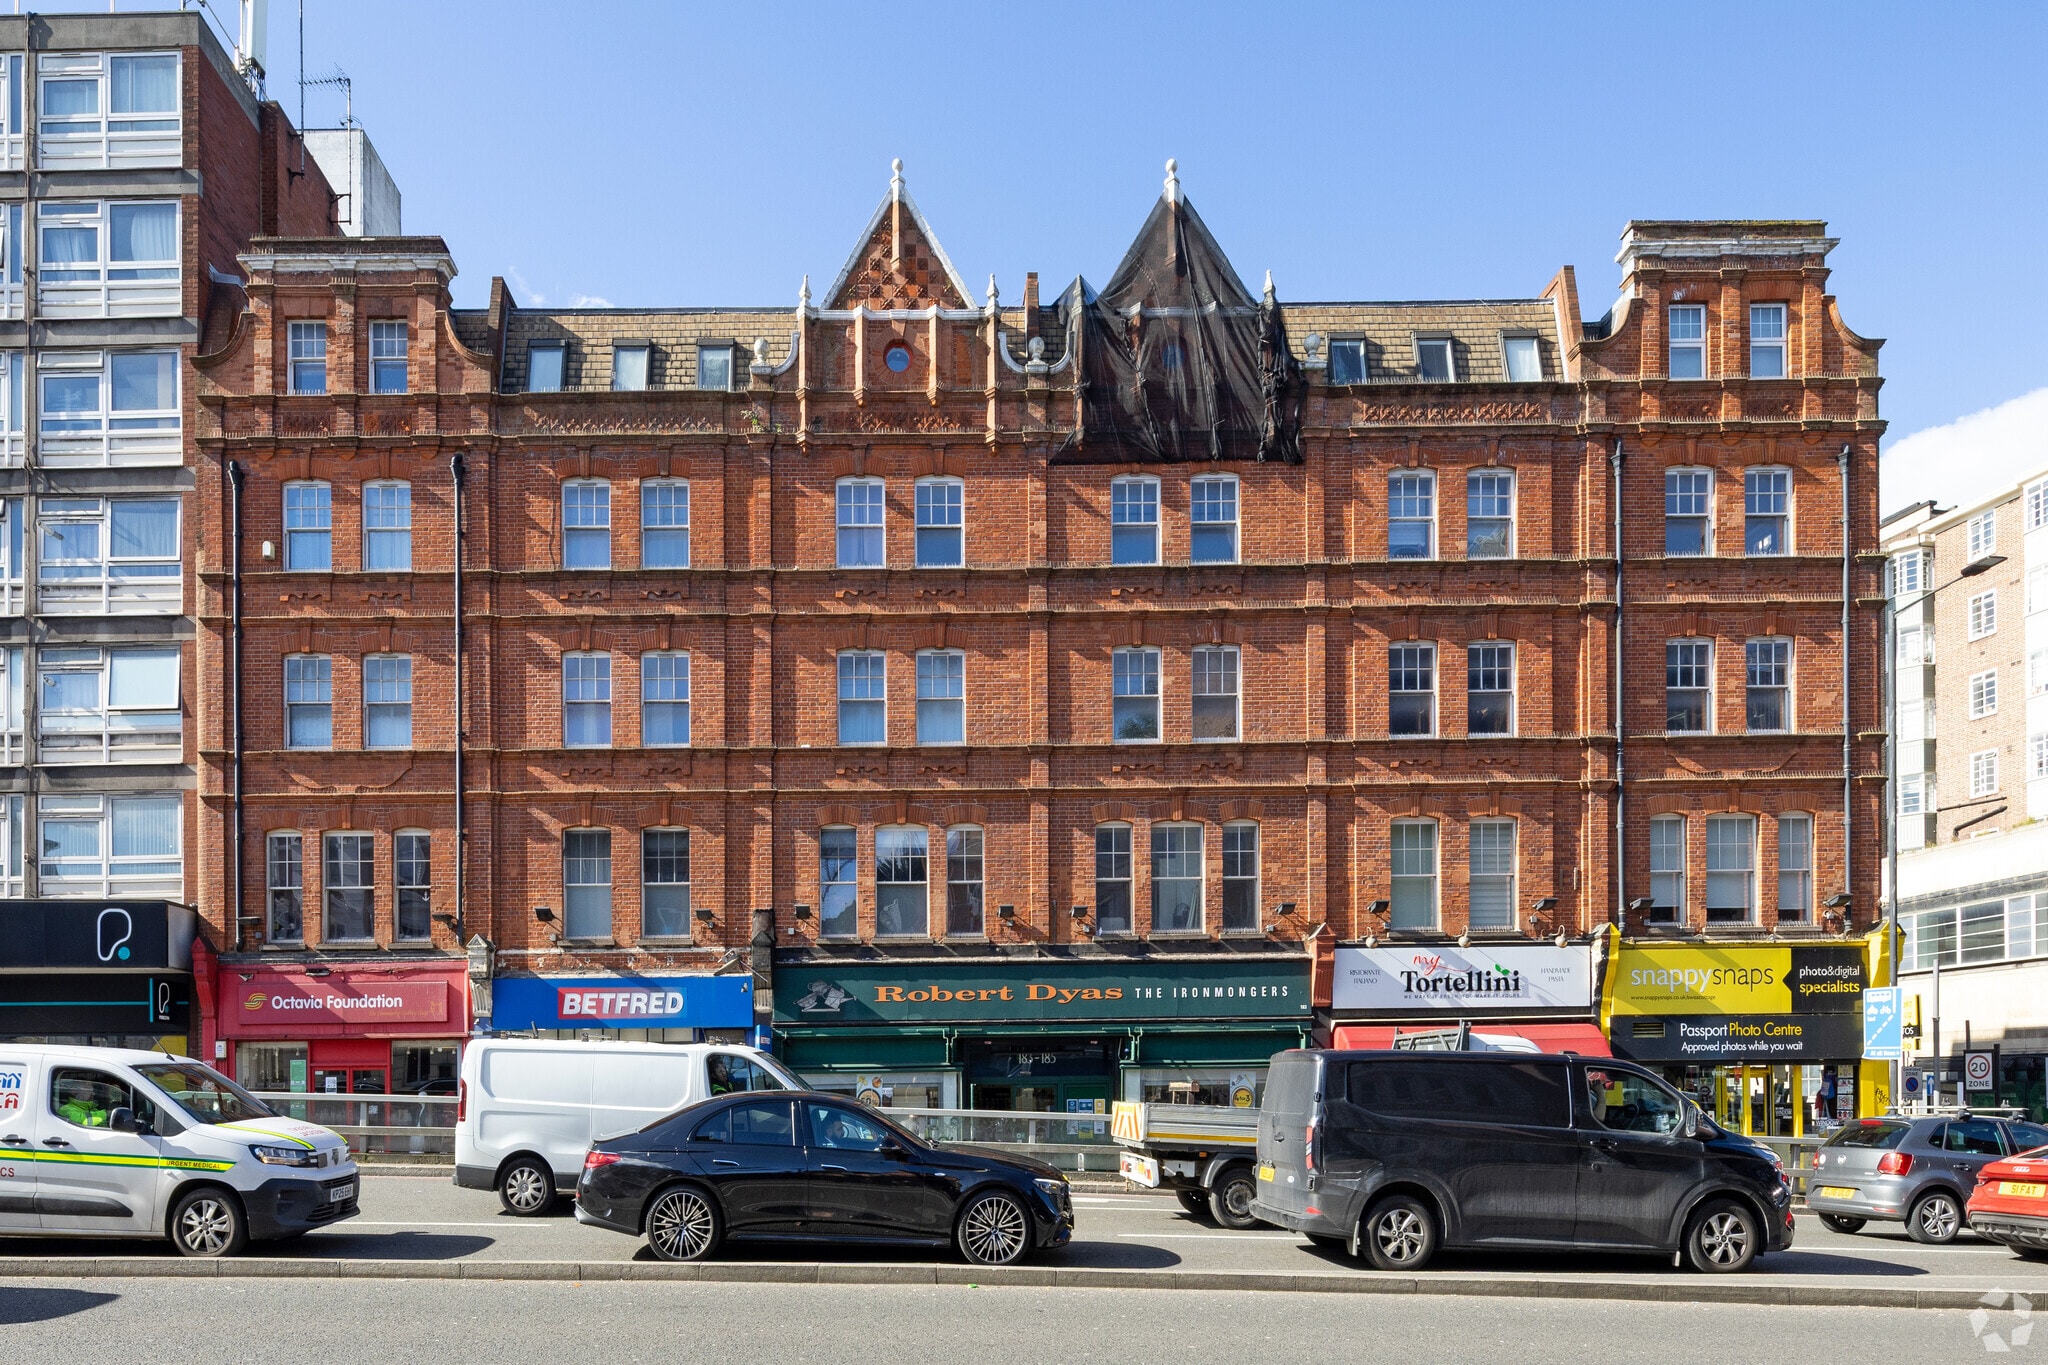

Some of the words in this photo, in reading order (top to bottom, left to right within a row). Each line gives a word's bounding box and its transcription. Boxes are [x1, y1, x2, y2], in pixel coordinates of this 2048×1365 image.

[1799, 965, 1860, 978] photo&digital
[1400, 968, 1521, 993] Tortellini
[1631, 966, 1774, 993] snappysnaps
[874, 985, 1014, 1003] Robert
[1025, 984, 1123, 1004] Dyas
[1135, 987, 1162, 999] THE
[1173, 986, 1288, 998] IRONMONGERS
[1799, 981, 1860, 995] specialists
[271, 995, 323, 1009] Octavia
[327, 994, 403, 1009] Foundation
[562, 992, 684, 1015] BETFRED
[1680, 1022, 1728, 1040] Passport
[1729, 1022, 1761, 1036] Photo
[1764, 1022, 1803, 1036] Centre
[1681, 1041, 1720, 1053] Approved
[1720, 1041, 1747, 1053] photos
[1747, 1040, 1769, 1050] while
[1769, 1043, 1785, 1053] you
[1785, 1041, 1803, 1051] wait
[1970, 1062, 1987, 1073] 20
[1245, 1094, 1251, 1102] 3
